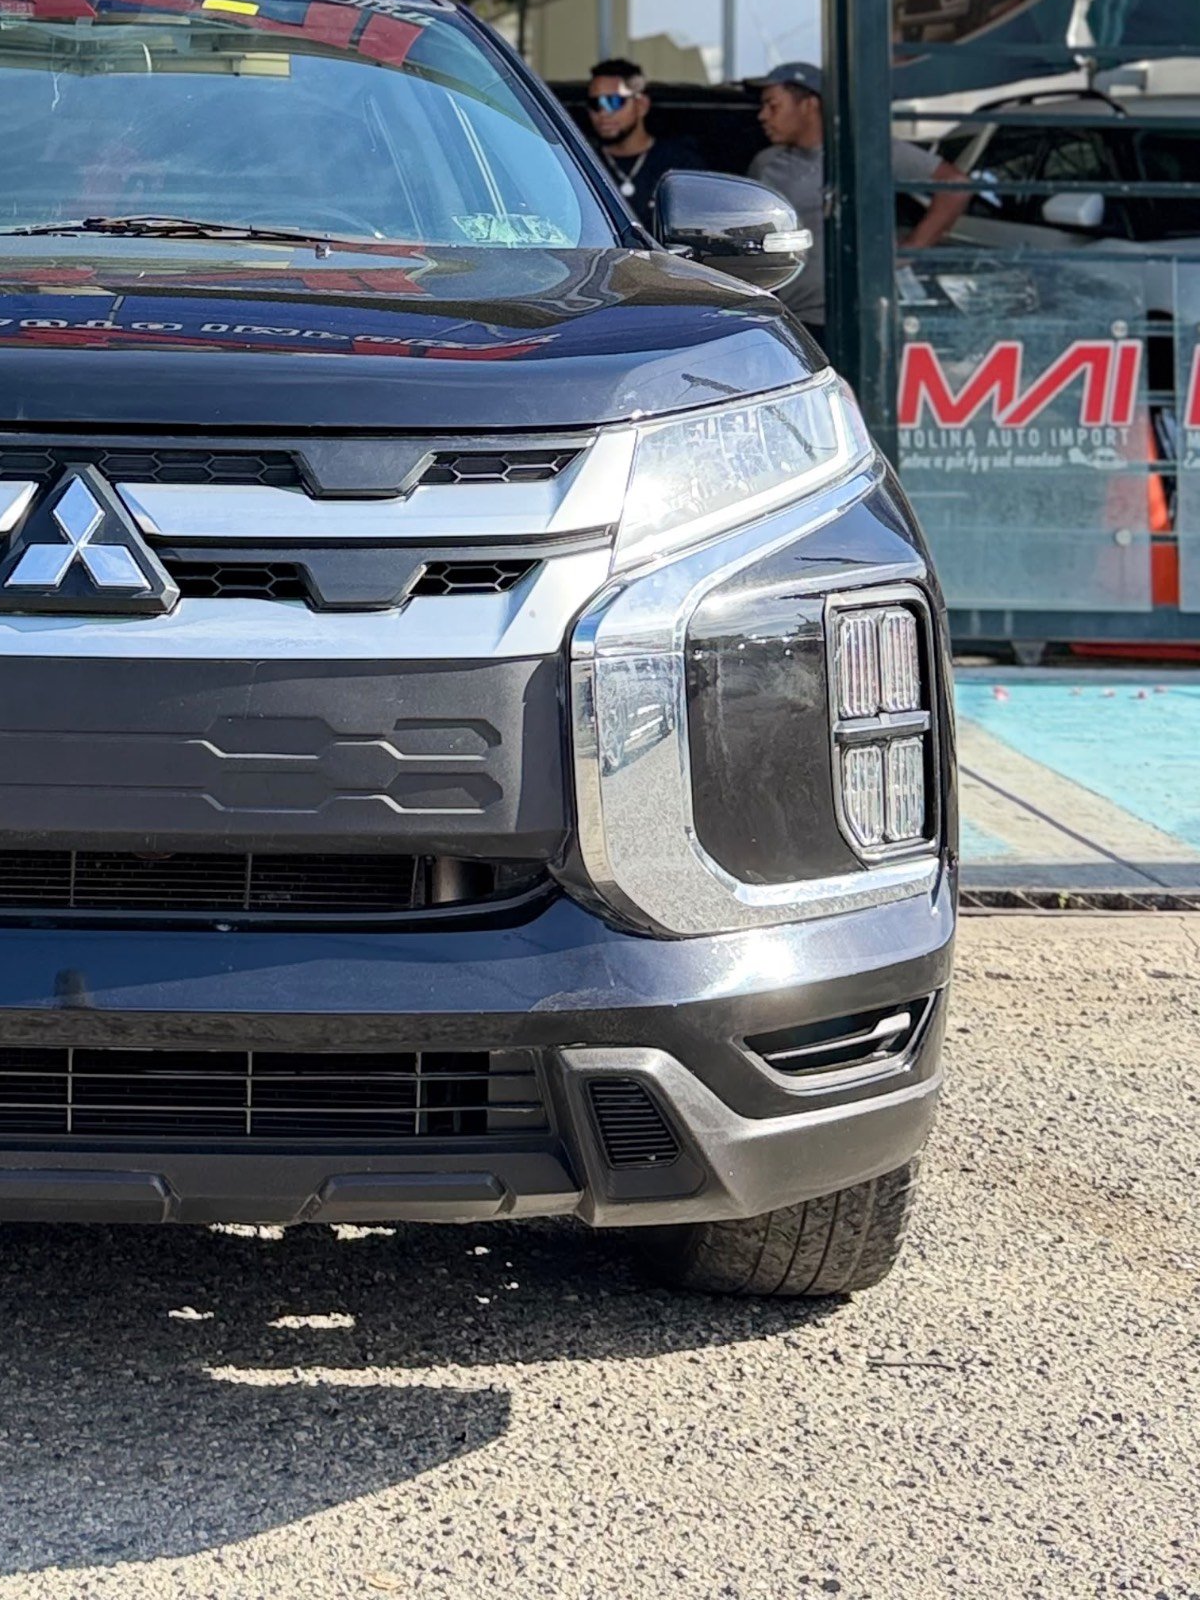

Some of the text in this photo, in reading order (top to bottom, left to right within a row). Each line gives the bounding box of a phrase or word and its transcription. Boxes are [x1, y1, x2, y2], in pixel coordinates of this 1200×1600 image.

[897, 338, 1143, 429] MAI
[898, 427, 1131, 449] MOLINA AUTO IMPORT
